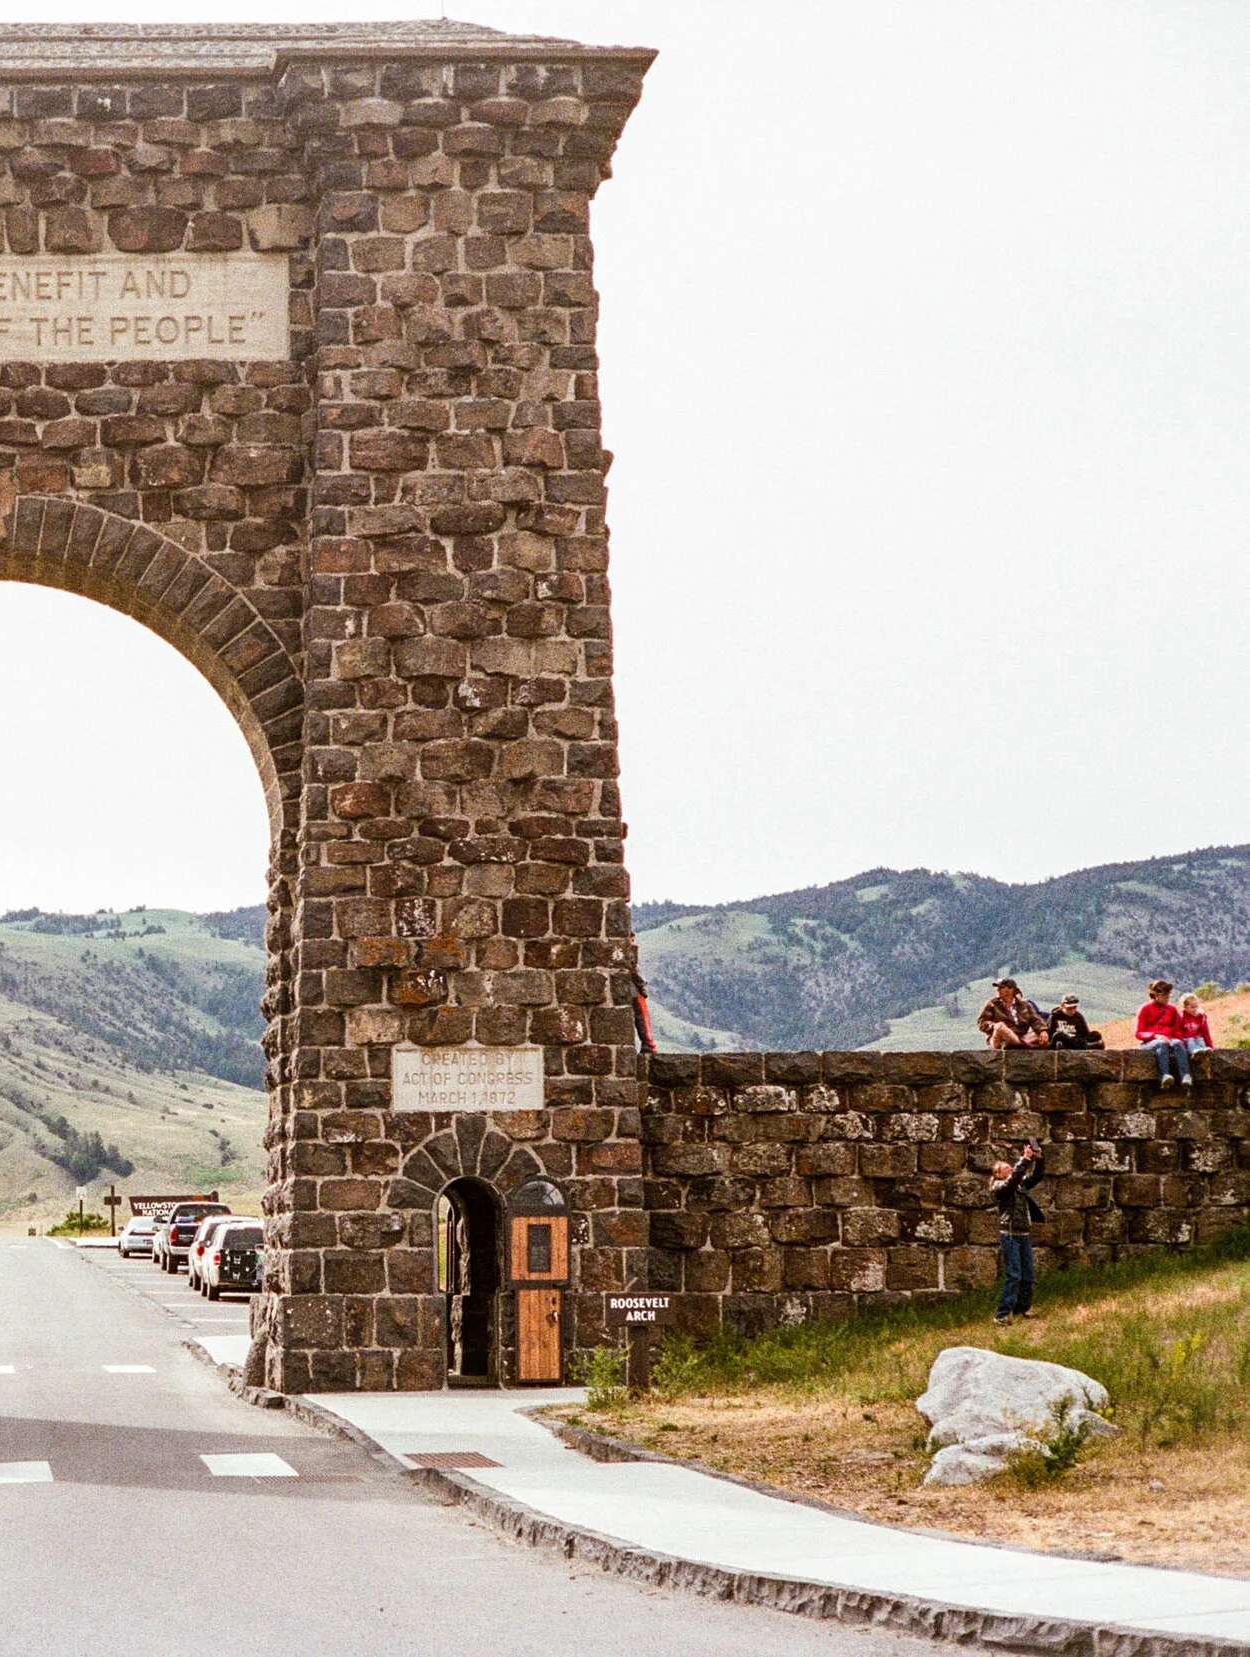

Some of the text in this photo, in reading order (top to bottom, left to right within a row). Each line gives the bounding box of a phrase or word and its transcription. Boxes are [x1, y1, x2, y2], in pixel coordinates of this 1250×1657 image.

[120, 270, 191, 299] AND
[29, 316, 94, 346] THE
[421, 1053, 514, 1066] CREATED BY
[403, 1072, 532, 1085] ACT OF CONGRESS
[418, 1092, 466, 1104] MARCH
[610, 1297, 670, 1309] ROOSEVELT
[626, 1310, 656, 1321] ARCH
